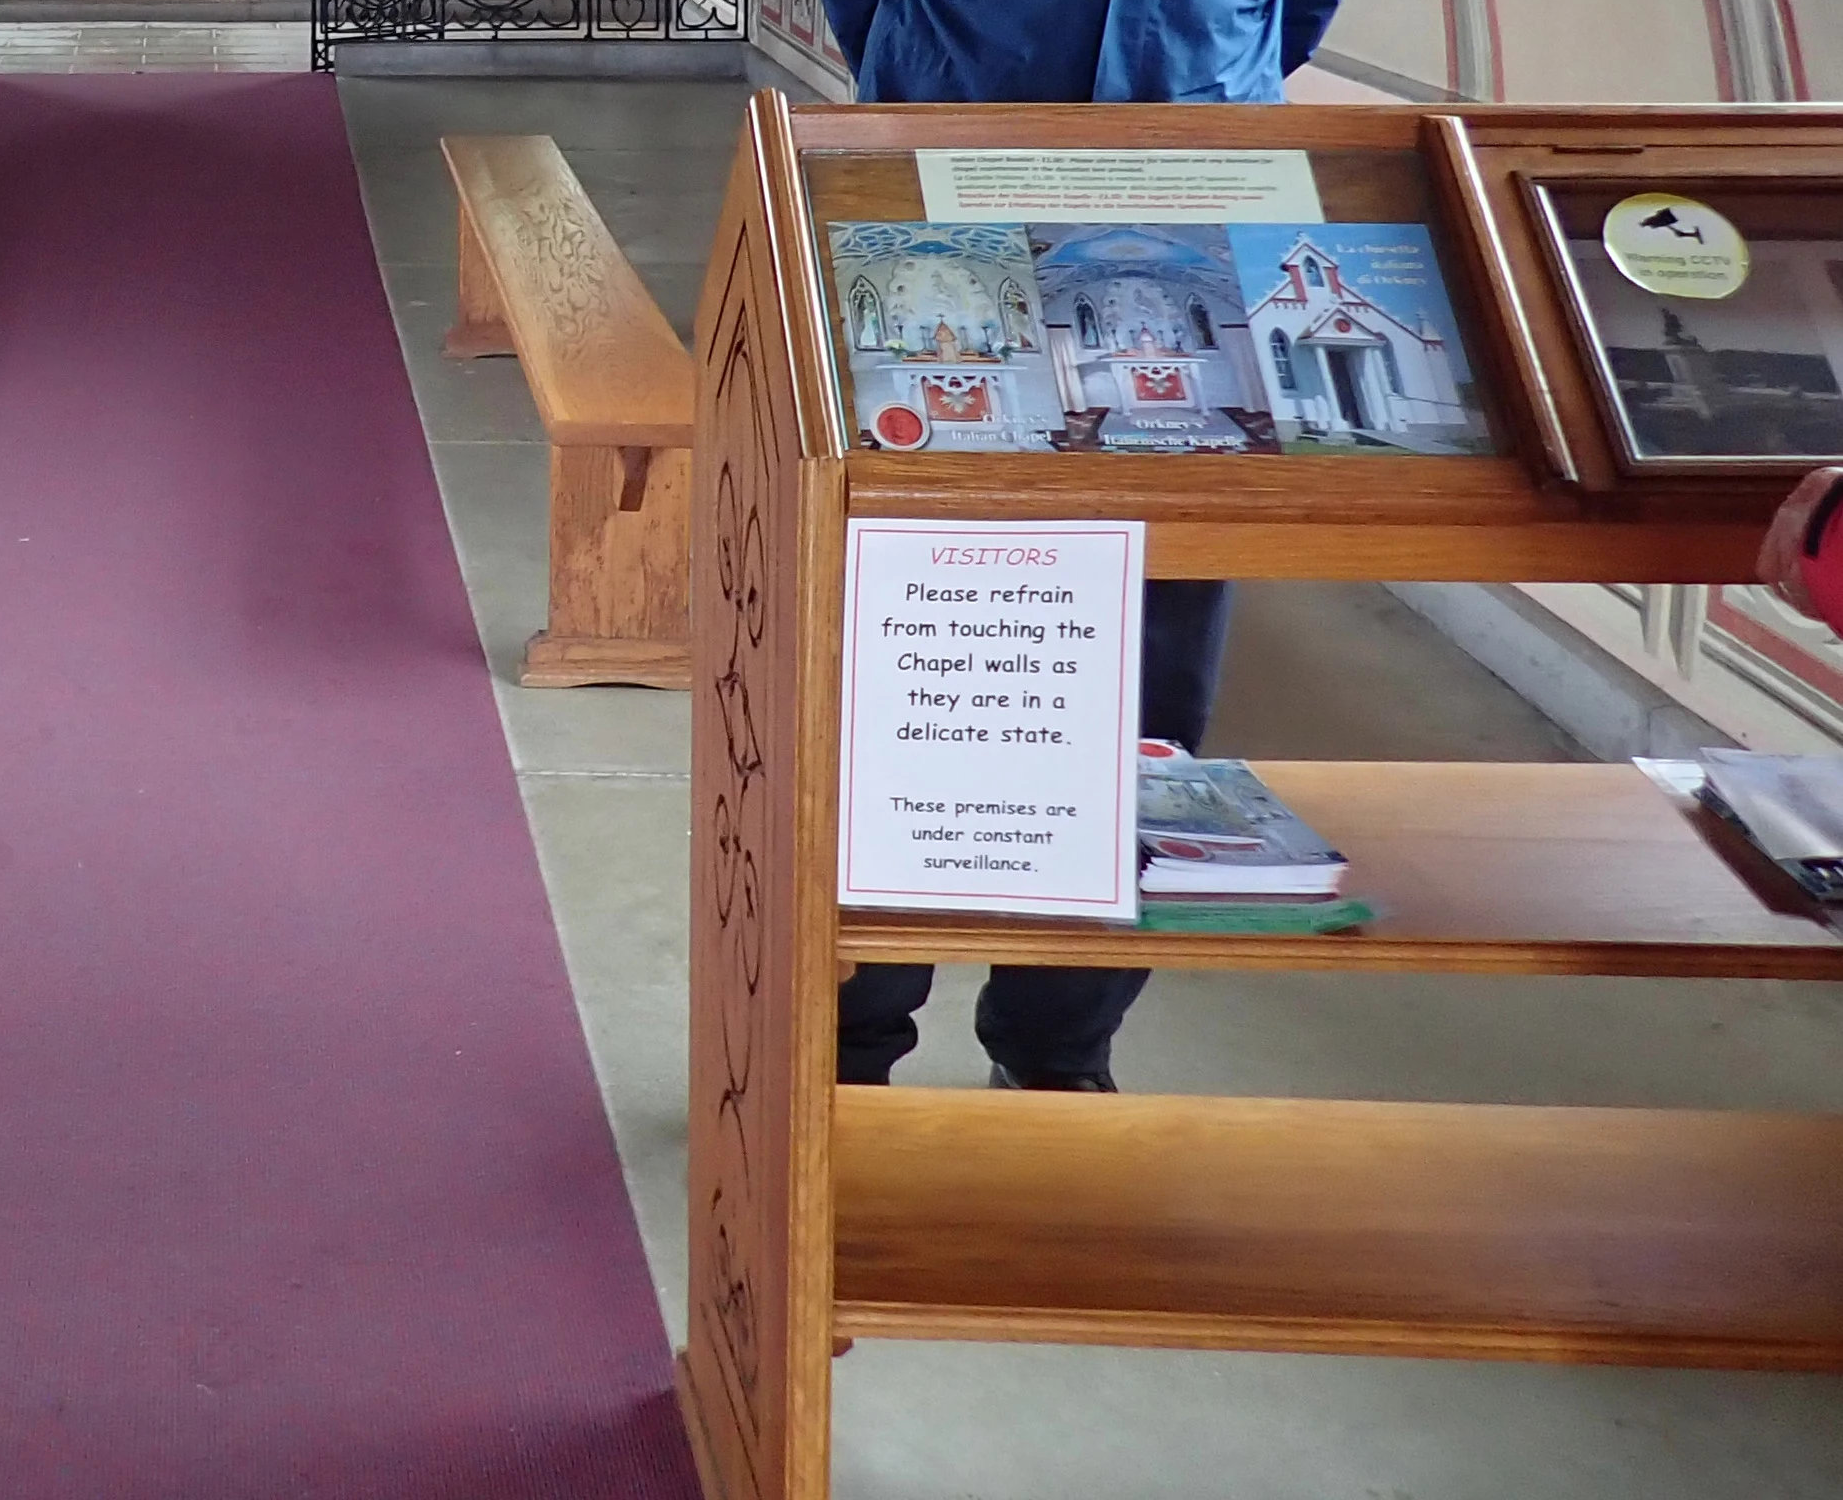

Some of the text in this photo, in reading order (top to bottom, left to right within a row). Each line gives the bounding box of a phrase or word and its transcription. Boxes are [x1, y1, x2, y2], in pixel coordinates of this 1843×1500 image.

[1001, 430, 1052, 442] Chapel
[931, 547, 1058, 566] VISITORS
[906, 583, 1073, 603] Please refrain
[881, 618, 1096, 643] from touching the
[898, 654, 1077, 676] Chapel walls as
[908, 689, 1065, 712] they are in a
[897, 723, 1071, 745] delicate state.
[890, 797, 1076, 817] These premises are
[912, 828, 1053, 844] under constant
[924, 856, 1038, 872] surveillance.
